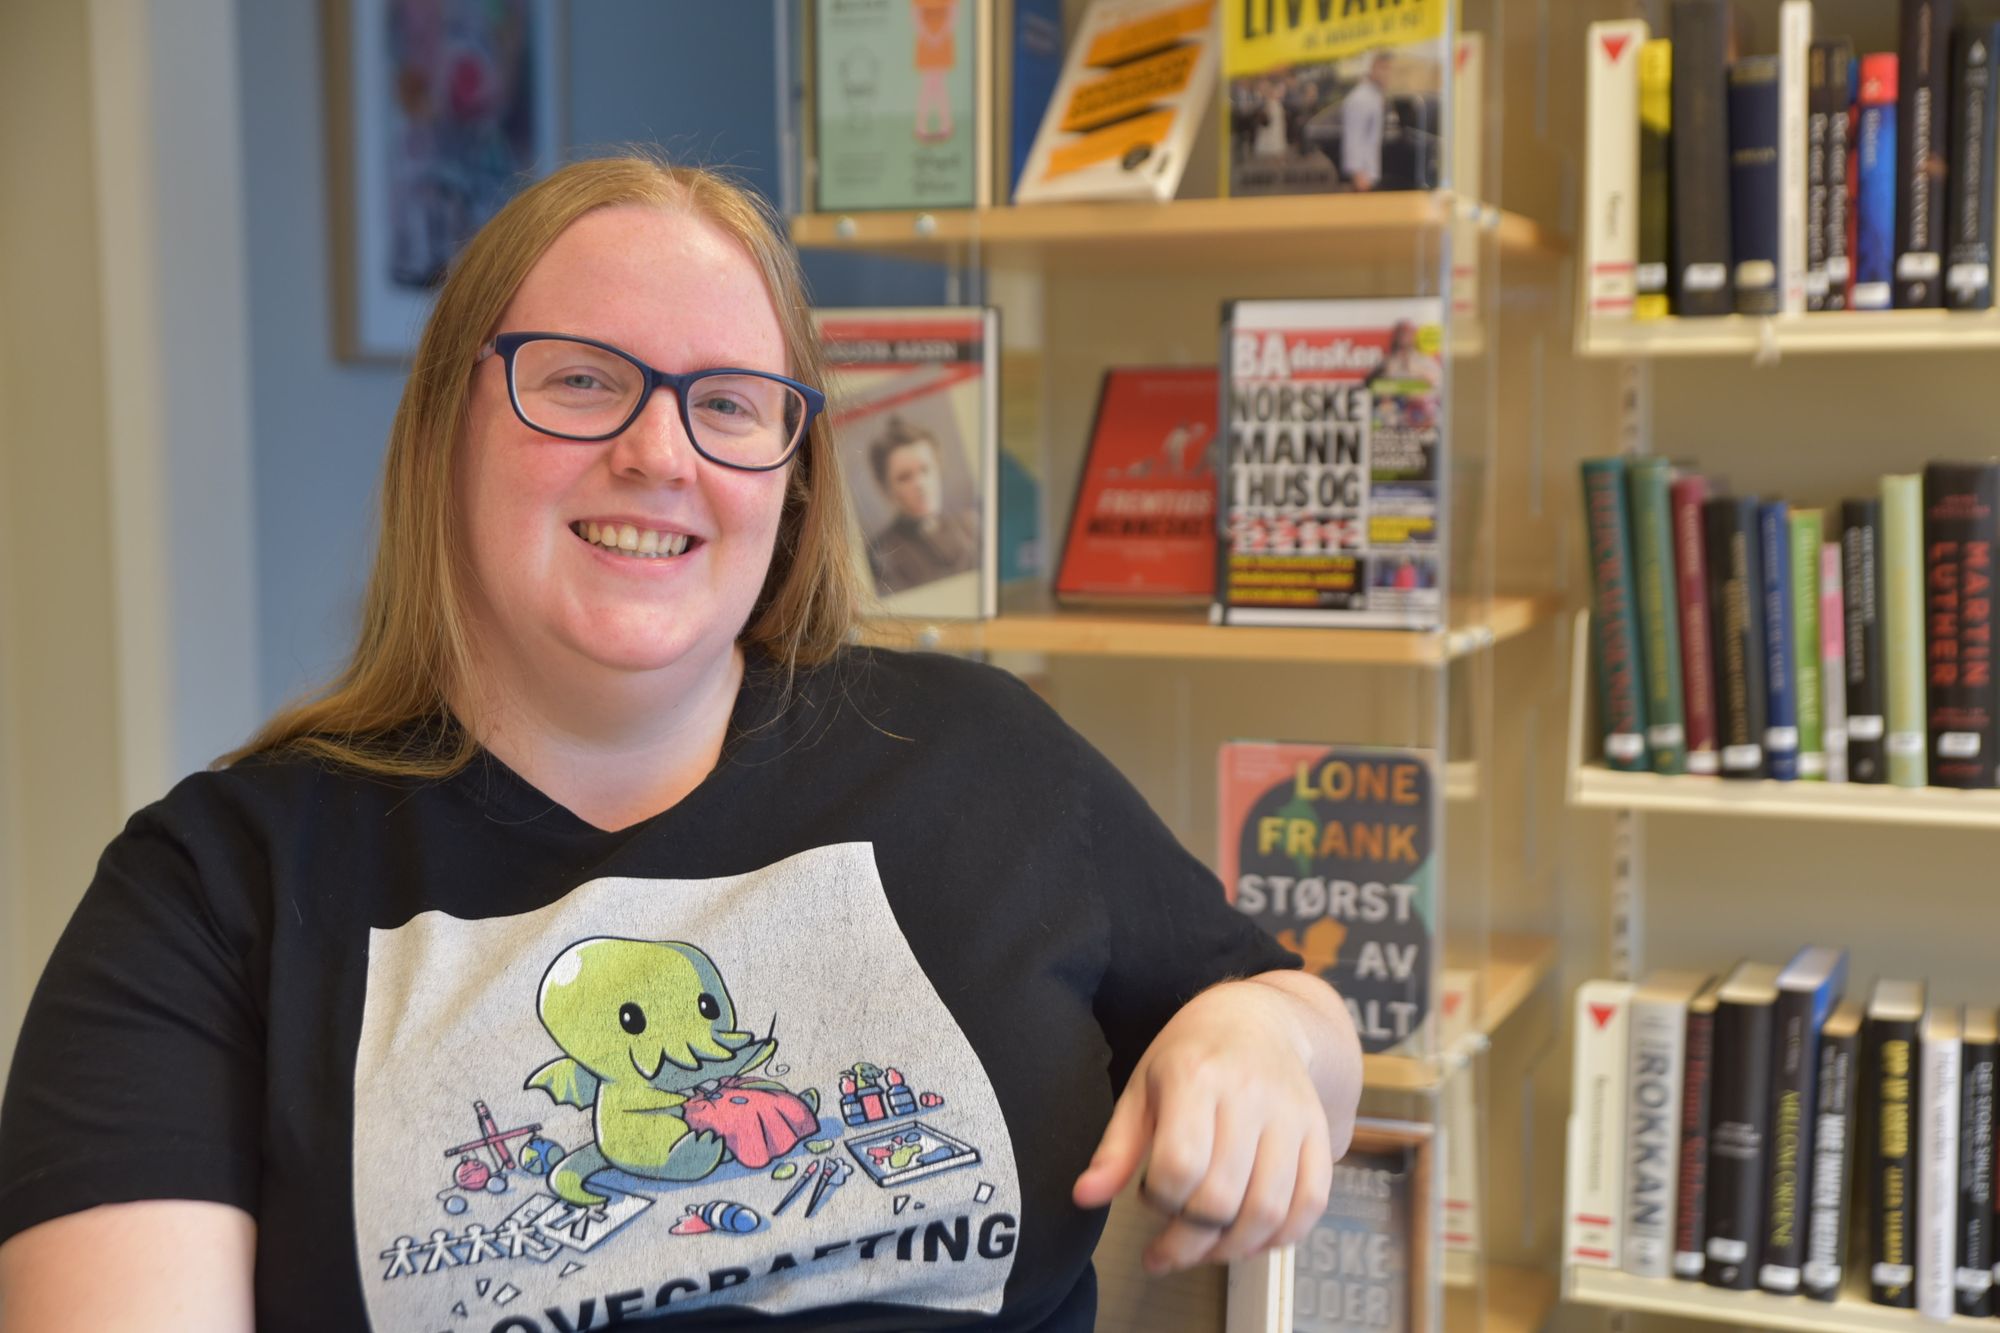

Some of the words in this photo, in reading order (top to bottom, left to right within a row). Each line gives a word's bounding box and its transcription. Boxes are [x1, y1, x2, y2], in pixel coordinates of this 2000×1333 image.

[1229, 384, 1364, 422] NORSKE
[1229, 428, 1361, 464] MANN
[1249, 470, 1309, 508] HUS
[1318, 471, 1360, 508] OG
[1931, 541, 1960, 687] LUTHER
[1960, 541, 1991, 687] MARTIN
[1295, 760, 1421, 805] LONE
[1257, 816, 1421, 864] FRANK
[1238, 872, 1419, 923] STØRST
[1356, 940, 1419, 981] AV
[1346, 997, 1418, 1040] ALT
[1633, 1052, 1670, 1227] ROKKAN
[1975, 1095, 1992, 1143] STORE
[436, 1213, 1016, 1333] VECRTING
[1296, 1227, 1392, 1280] SKE
[1294, 1275, 1392, 1328] ODER
